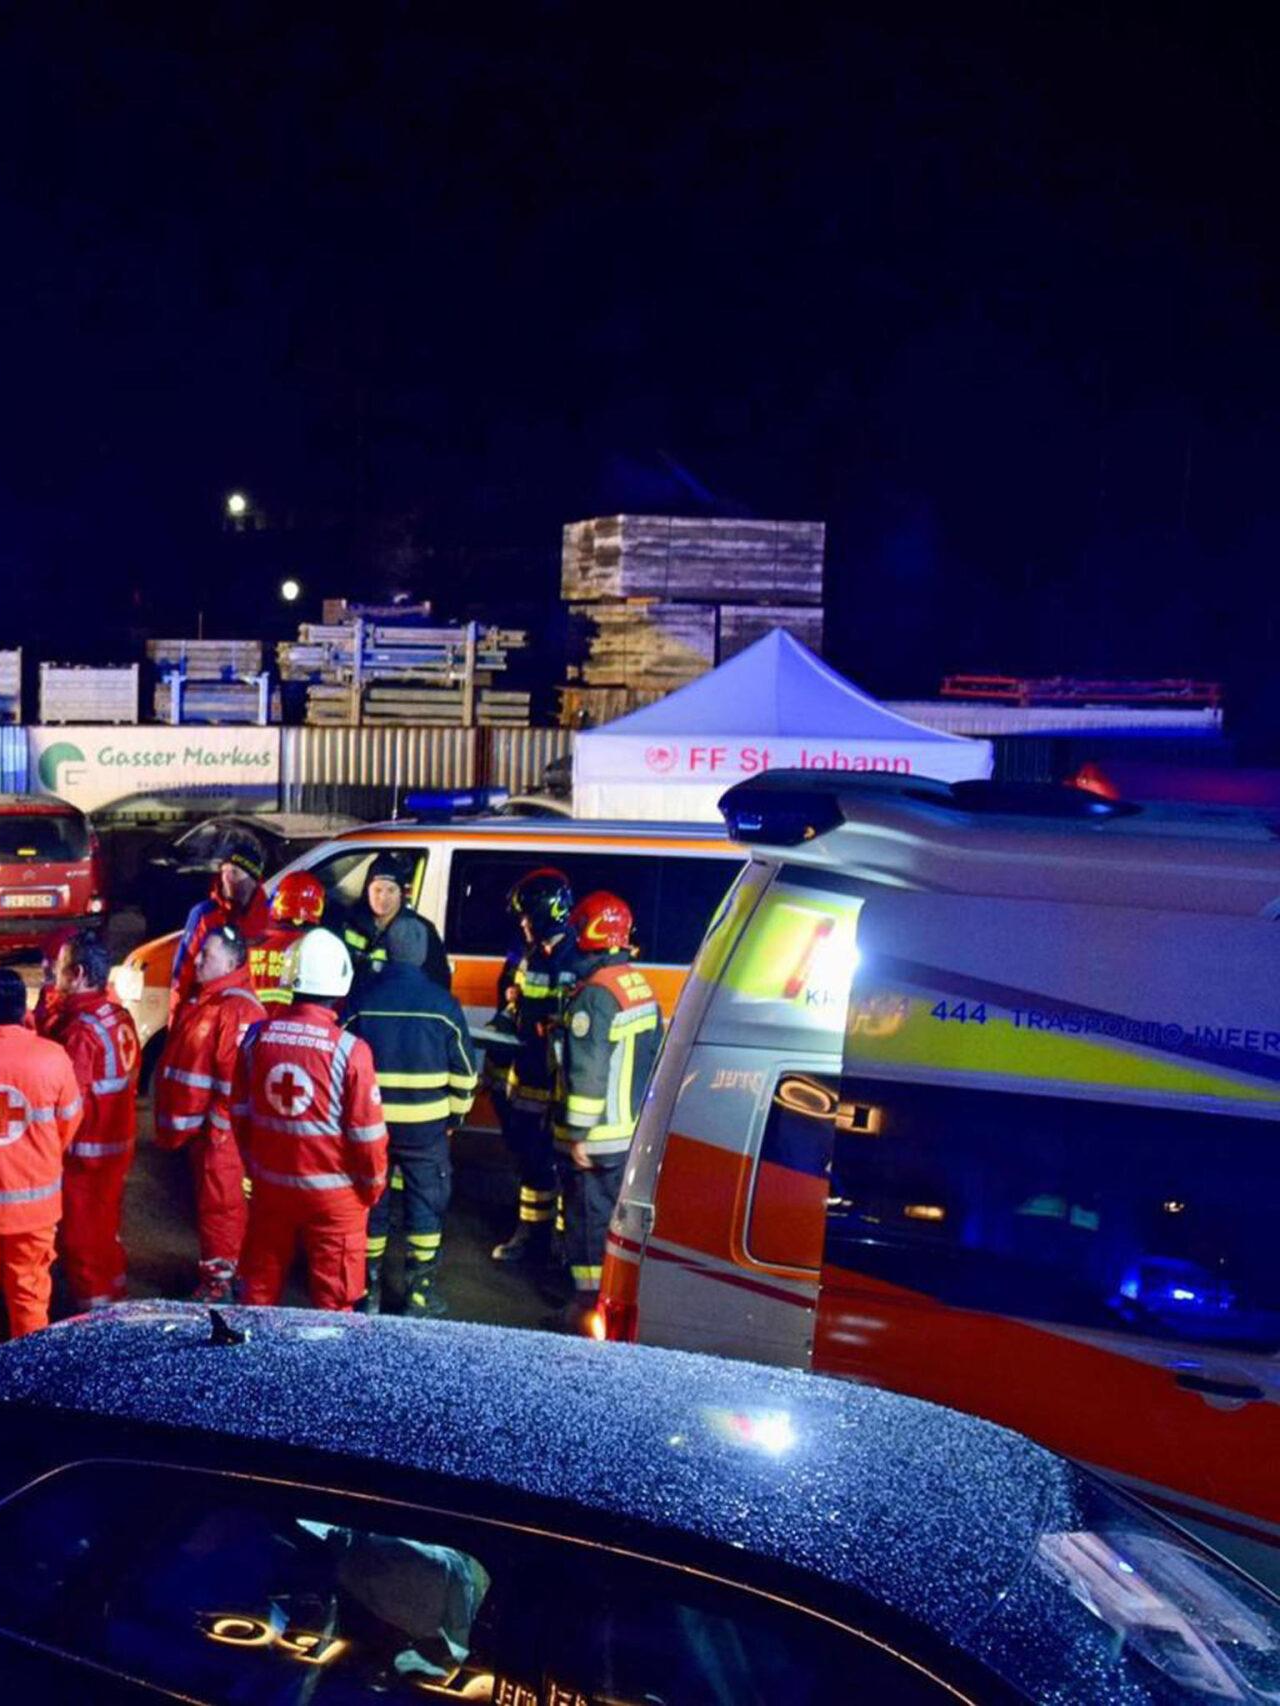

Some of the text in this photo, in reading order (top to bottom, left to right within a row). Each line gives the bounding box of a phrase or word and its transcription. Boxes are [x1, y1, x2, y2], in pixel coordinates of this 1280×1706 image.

[97, 746, 271, 767] Gasser Markus
[689, 748, 726, 771] FF
[930, 1000, 988, 1025] 444
[1011, 1009, 1186, 1049] TRASPORTO
